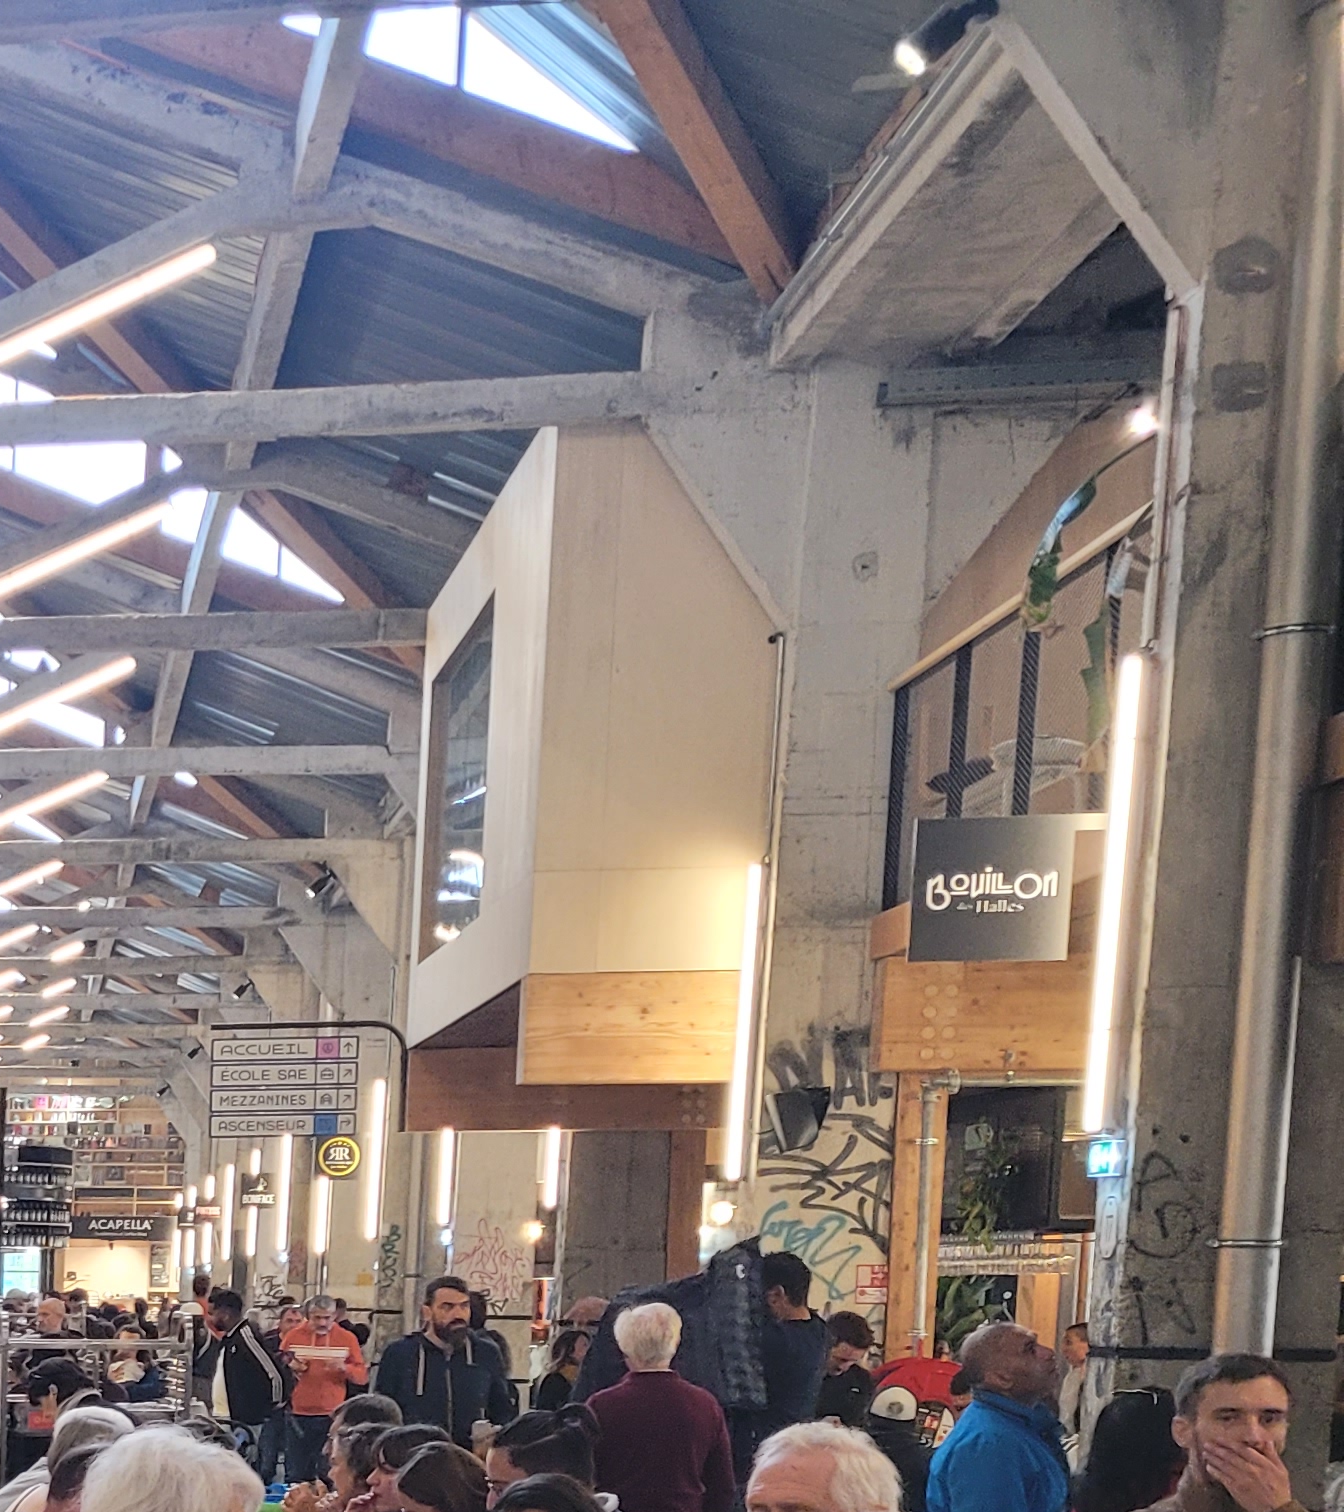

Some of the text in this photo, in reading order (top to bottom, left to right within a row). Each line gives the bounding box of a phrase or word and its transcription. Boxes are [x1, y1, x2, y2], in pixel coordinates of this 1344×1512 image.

[220, 1043, 308, 1056] ACCUEIL
[221, 1066, 308, 1081] ÉCOLE SAE
[219, 1094, 307, 1107] MEZZANINES
[218, 1120, 306, 1132] ASCENSEUR
[88, 1219, 152, 1231] ACAPELLA
